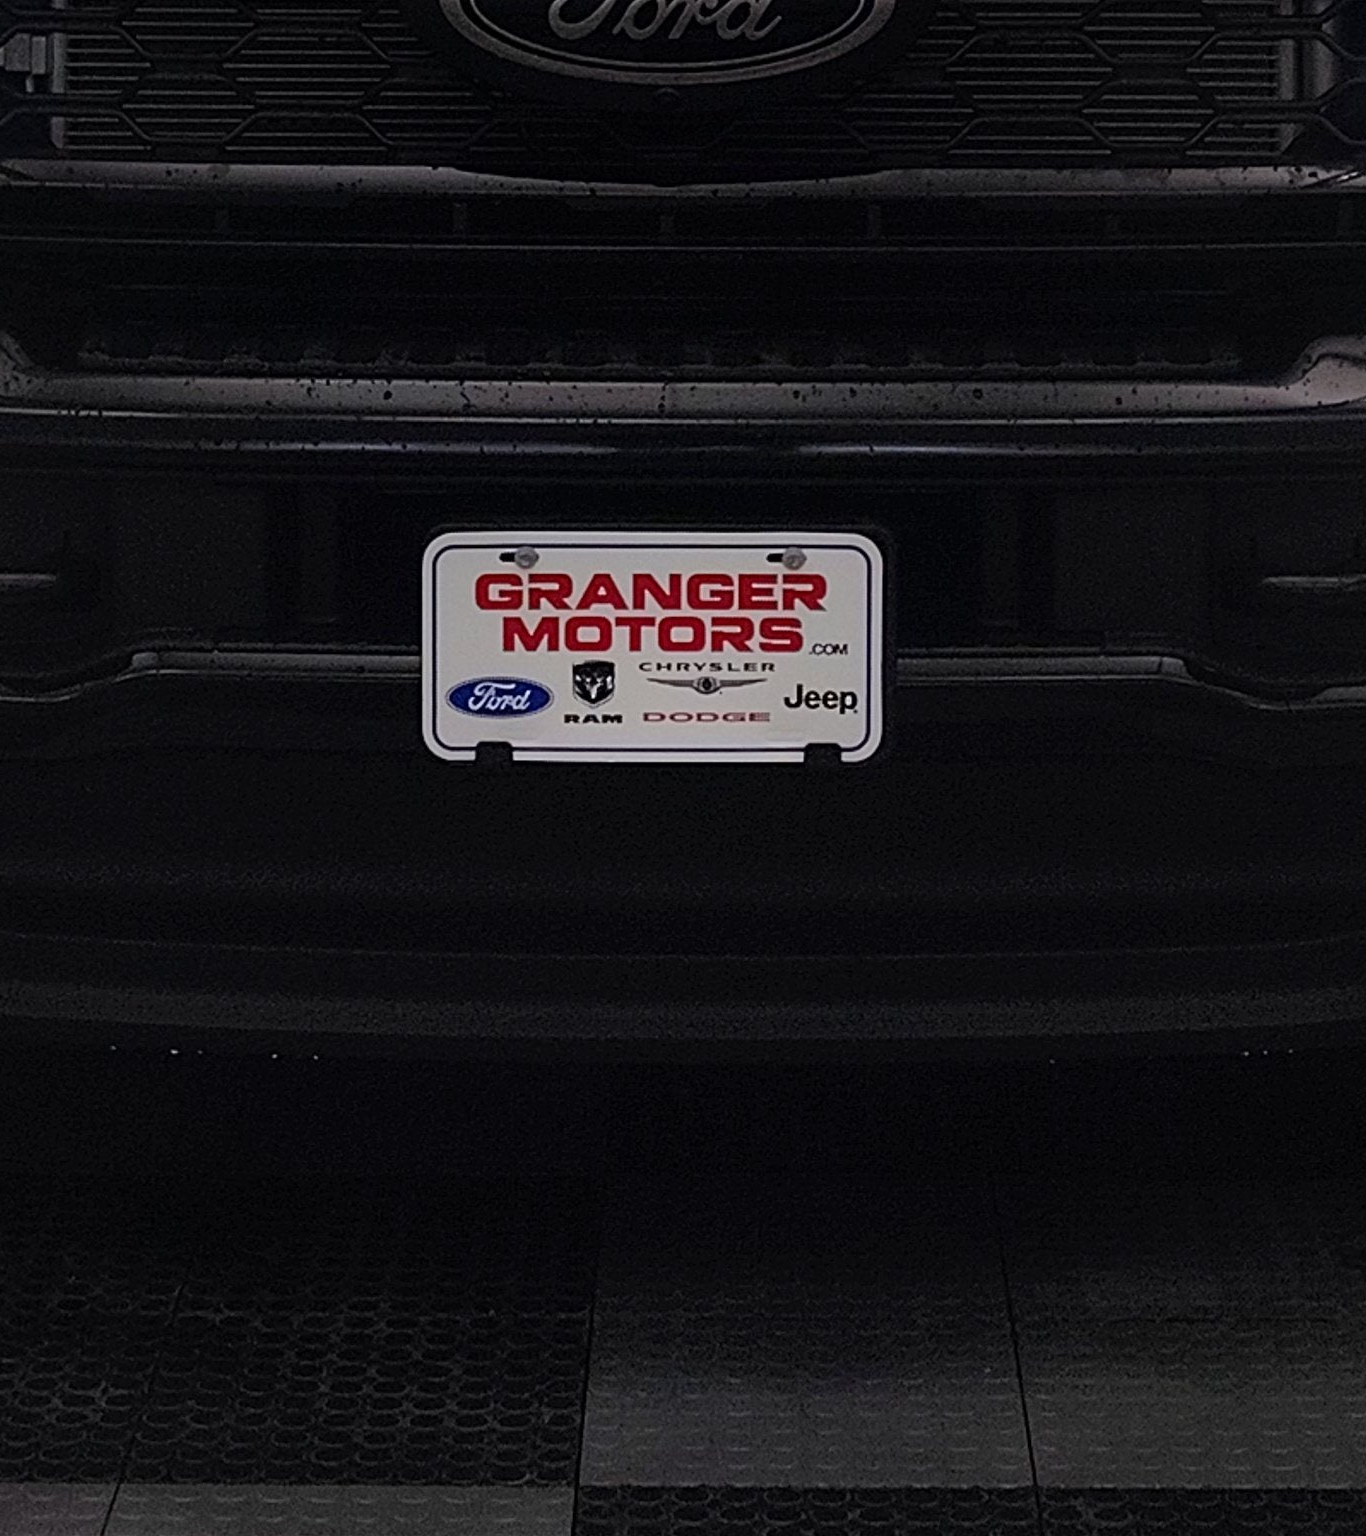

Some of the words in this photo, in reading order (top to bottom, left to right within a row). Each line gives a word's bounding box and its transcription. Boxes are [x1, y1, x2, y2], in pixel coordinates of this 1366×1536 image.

[475, 573, 827, 611] GRANGER
[502, 616, 803, 653] MOTORS
[808, 642, 849, 656] .COM
[638, 661, 776, 673] CHRYSLER
[467, 683, 531, 712] Ford
[784, 684, 859, 714] Jeep
[563, 713, 623, 724] RAM
[642, 711, 771, 723] DODGE
